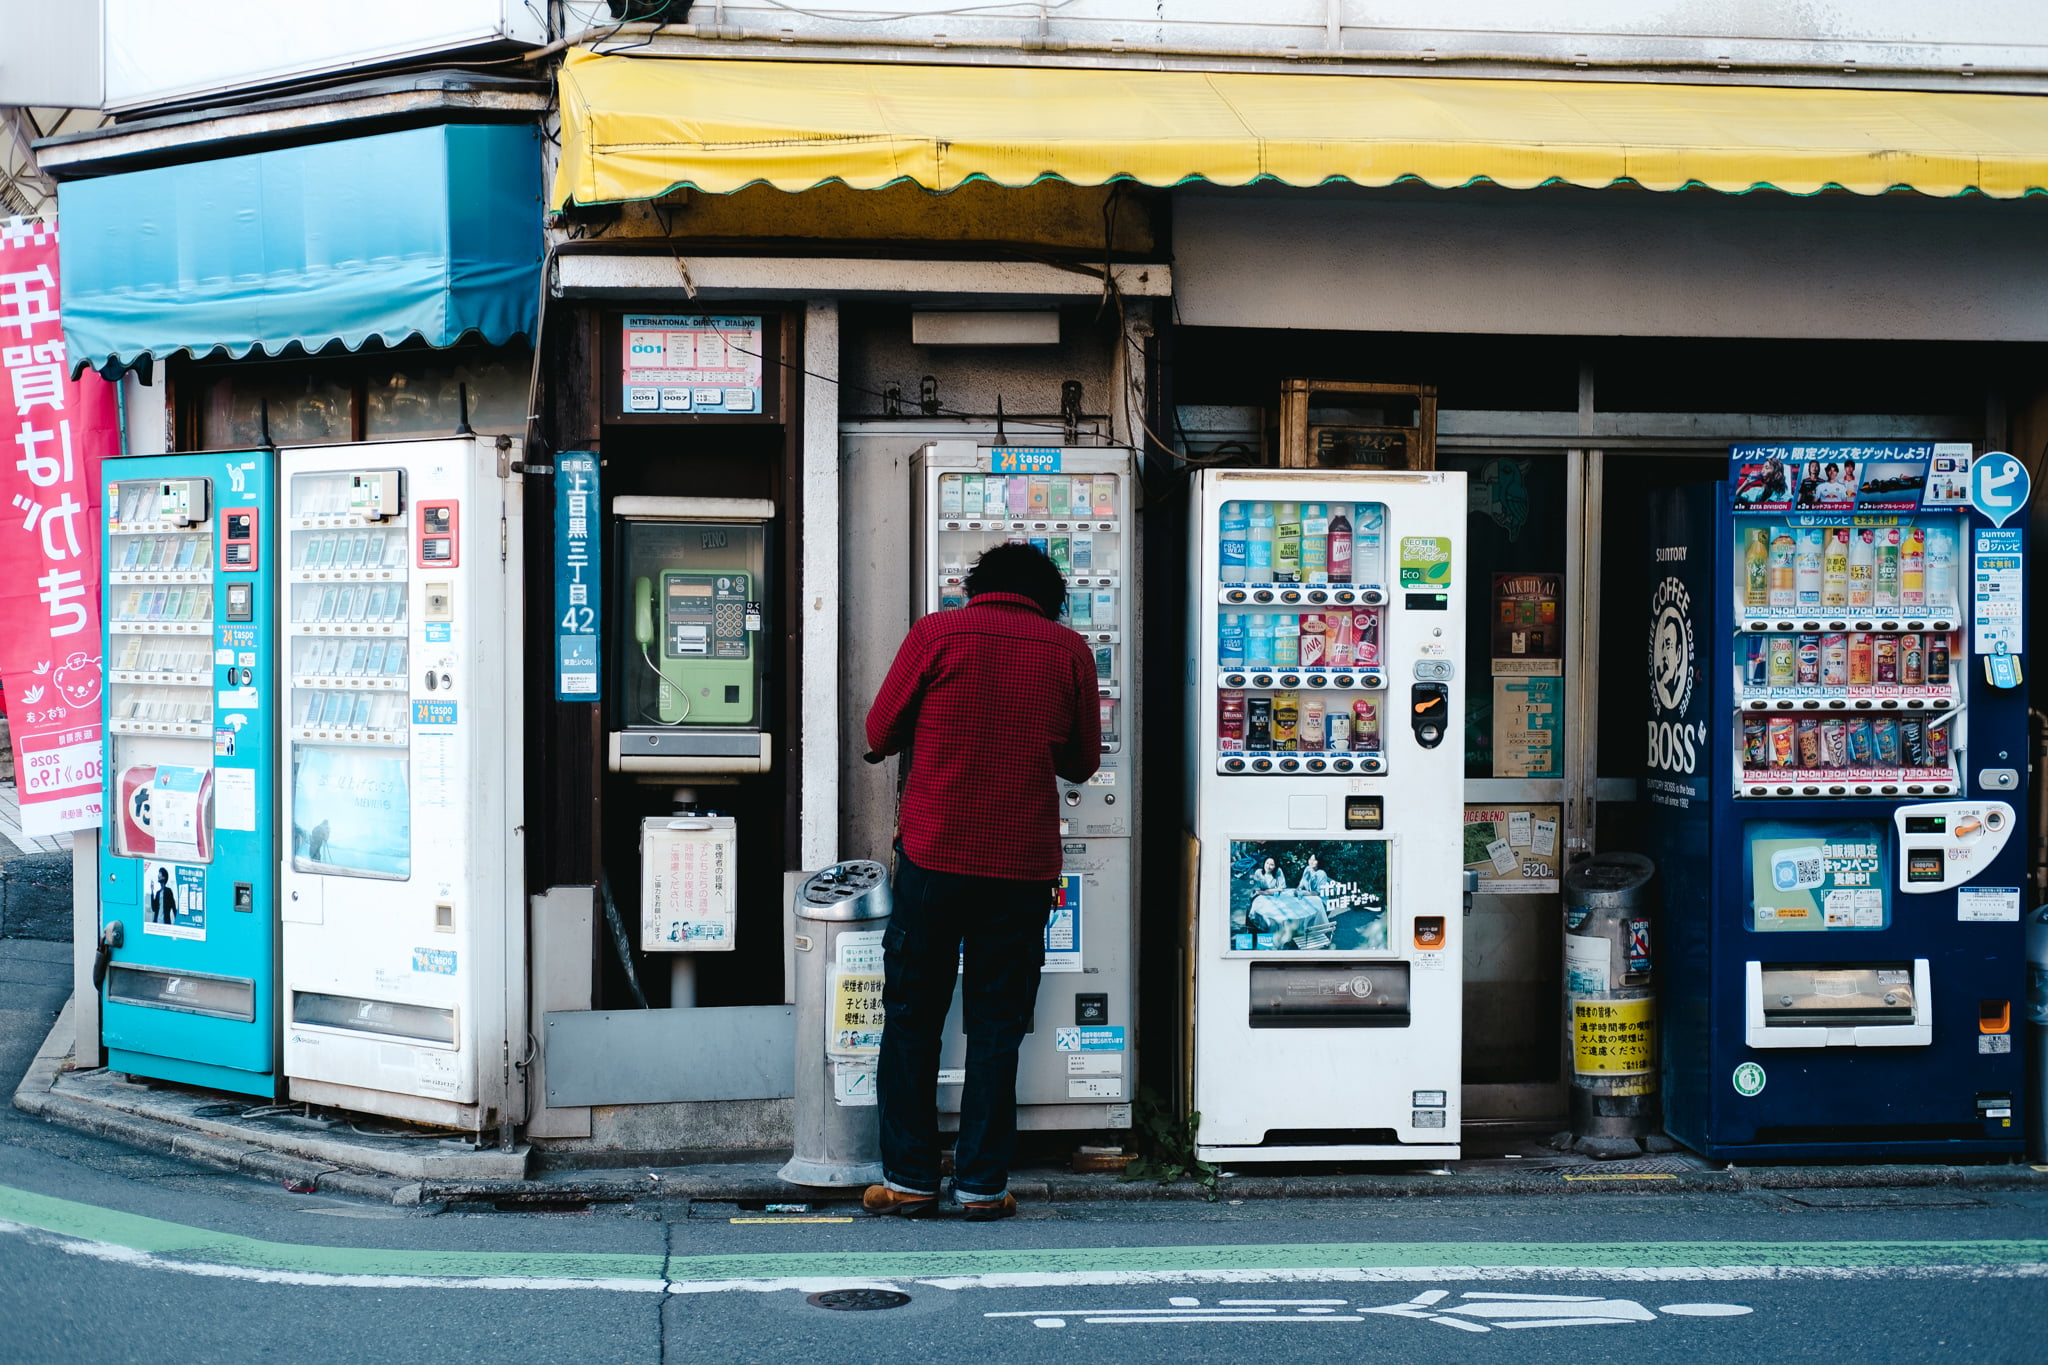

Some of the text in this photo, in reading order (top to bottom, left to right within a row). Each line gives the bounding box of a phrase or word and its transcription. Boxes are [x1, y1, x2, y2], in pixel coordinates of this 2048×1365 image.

[629, 319, 755, 328] INTERNATIONAL DIRECT DIALING
[631, 345, 662, 354] 001
[1019, 452, 1054, 466] taspo
[1732, 446, 1931, 460] レッドブル 限定グッズをゲットしよう!
[566, 473, 590, 605] 上目黒三丁目
[1656, 546, 1688, 562] SUNTORY
[1652, 576, 1691, 618] COFFEE
[1877, 607, 1900, 615] 170円
[561, 606, 595, 633] 42
[233, 630, 254, 641] taspo
[1303, 637, 1322, 661] JAVA
[1800, 665, 1817, 674] COLA
[1679, 665, 1695, 719] COFFEE
[1744, 687, 1767, 695] 220円
[1823, 687, 1846, 695] 150円
[1929, 686, 1951, 694] 170円
[430, 705, 453, 717] taspo
[1647, 720, 1696, 775] BOSS
[1908, 726, 1921, 765] BLACK
[1480, 810, 1505, 822] BLEND
[1822, 843, 1878, 858] 自販機限定
[1823, 857, 1879, 872] キャンペーン
[1834, 872, 1870, 885] 実施中!
